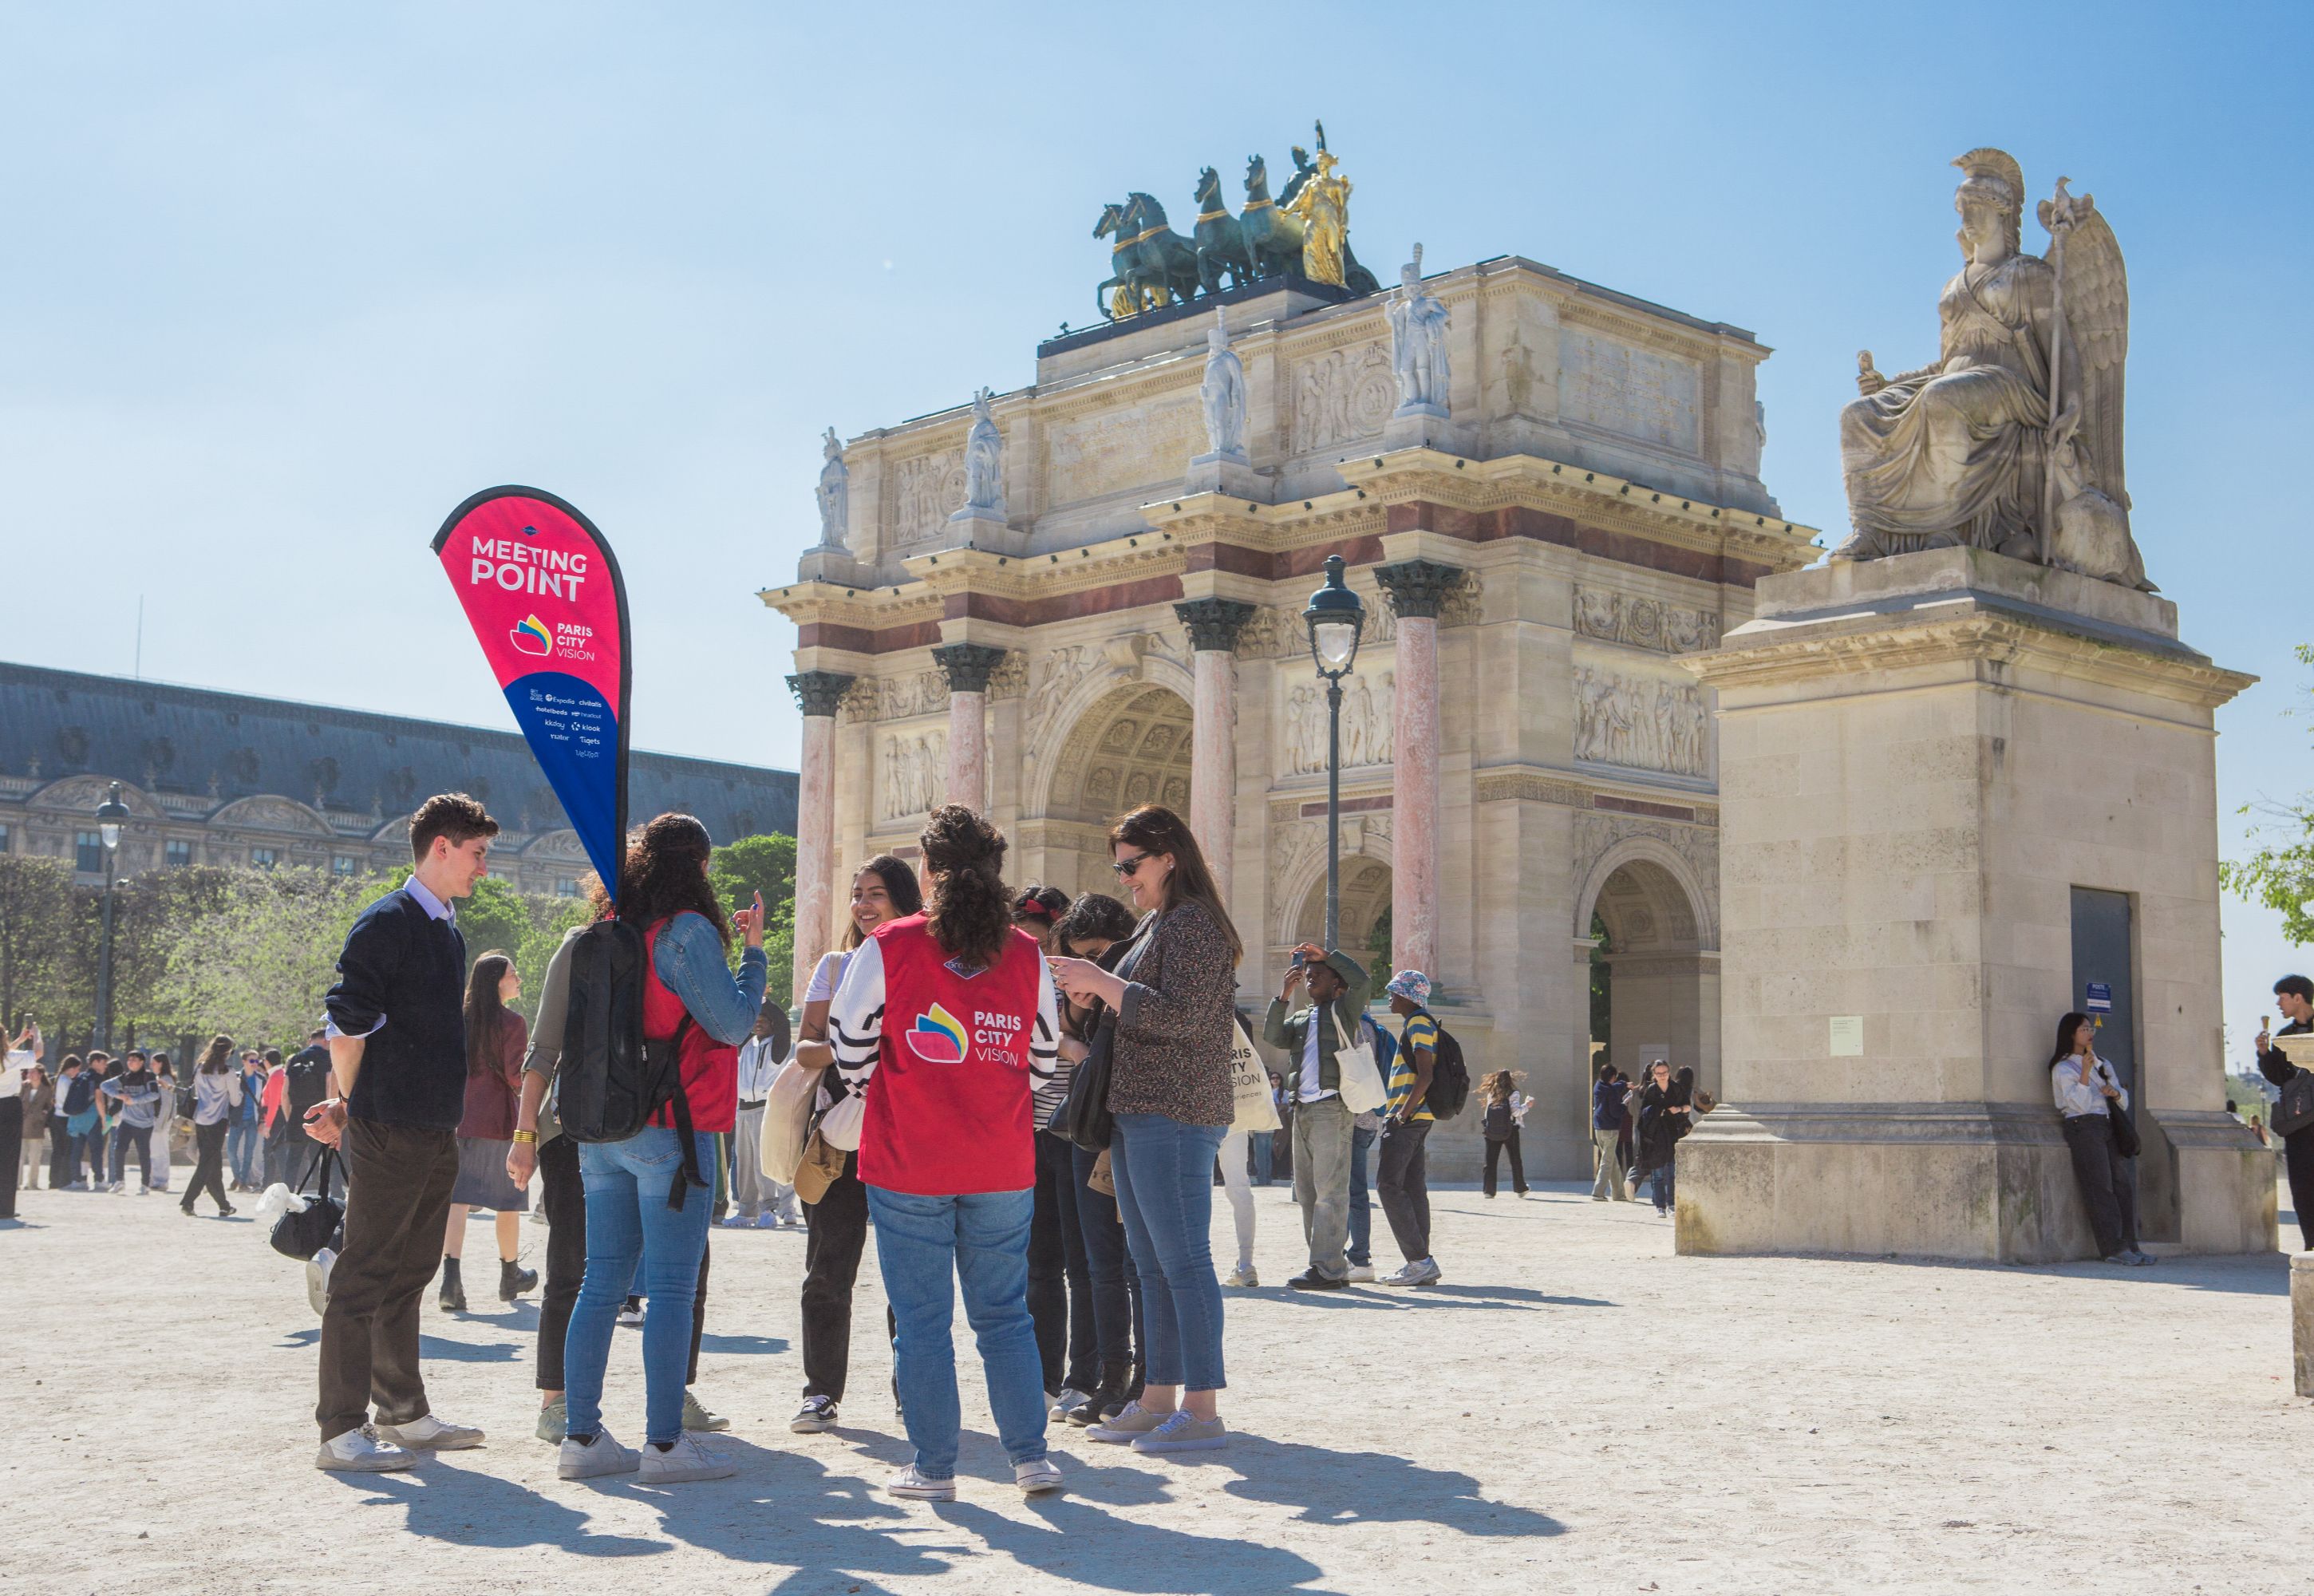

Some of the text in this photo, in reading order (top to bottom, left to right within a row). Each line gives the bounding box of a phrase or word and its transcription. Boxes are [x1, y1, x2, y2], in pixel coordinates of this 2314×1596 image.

[472, 536, 587, 573] MEETING
[471, 558, 585, 602] POINT
[557, 622, 593, 637] PARIS
[557, 635, 586, 648] CITY
[556, 647, 594, 662] VISION
[536, 706, 567, 716] hotelbeds
[579, 736, 600, 745] Tiqets
[974, 1011, 1021, 1030] PARIS
[974, 1029, 1013, 1046] CITY
[975, 1047, 1019, 1067] VISION
[1231, 1048, 1251, 1060] RIS
[1231, 1061, 1246, 1073] TY
[1232, 1073, 1261, 1088] SION
